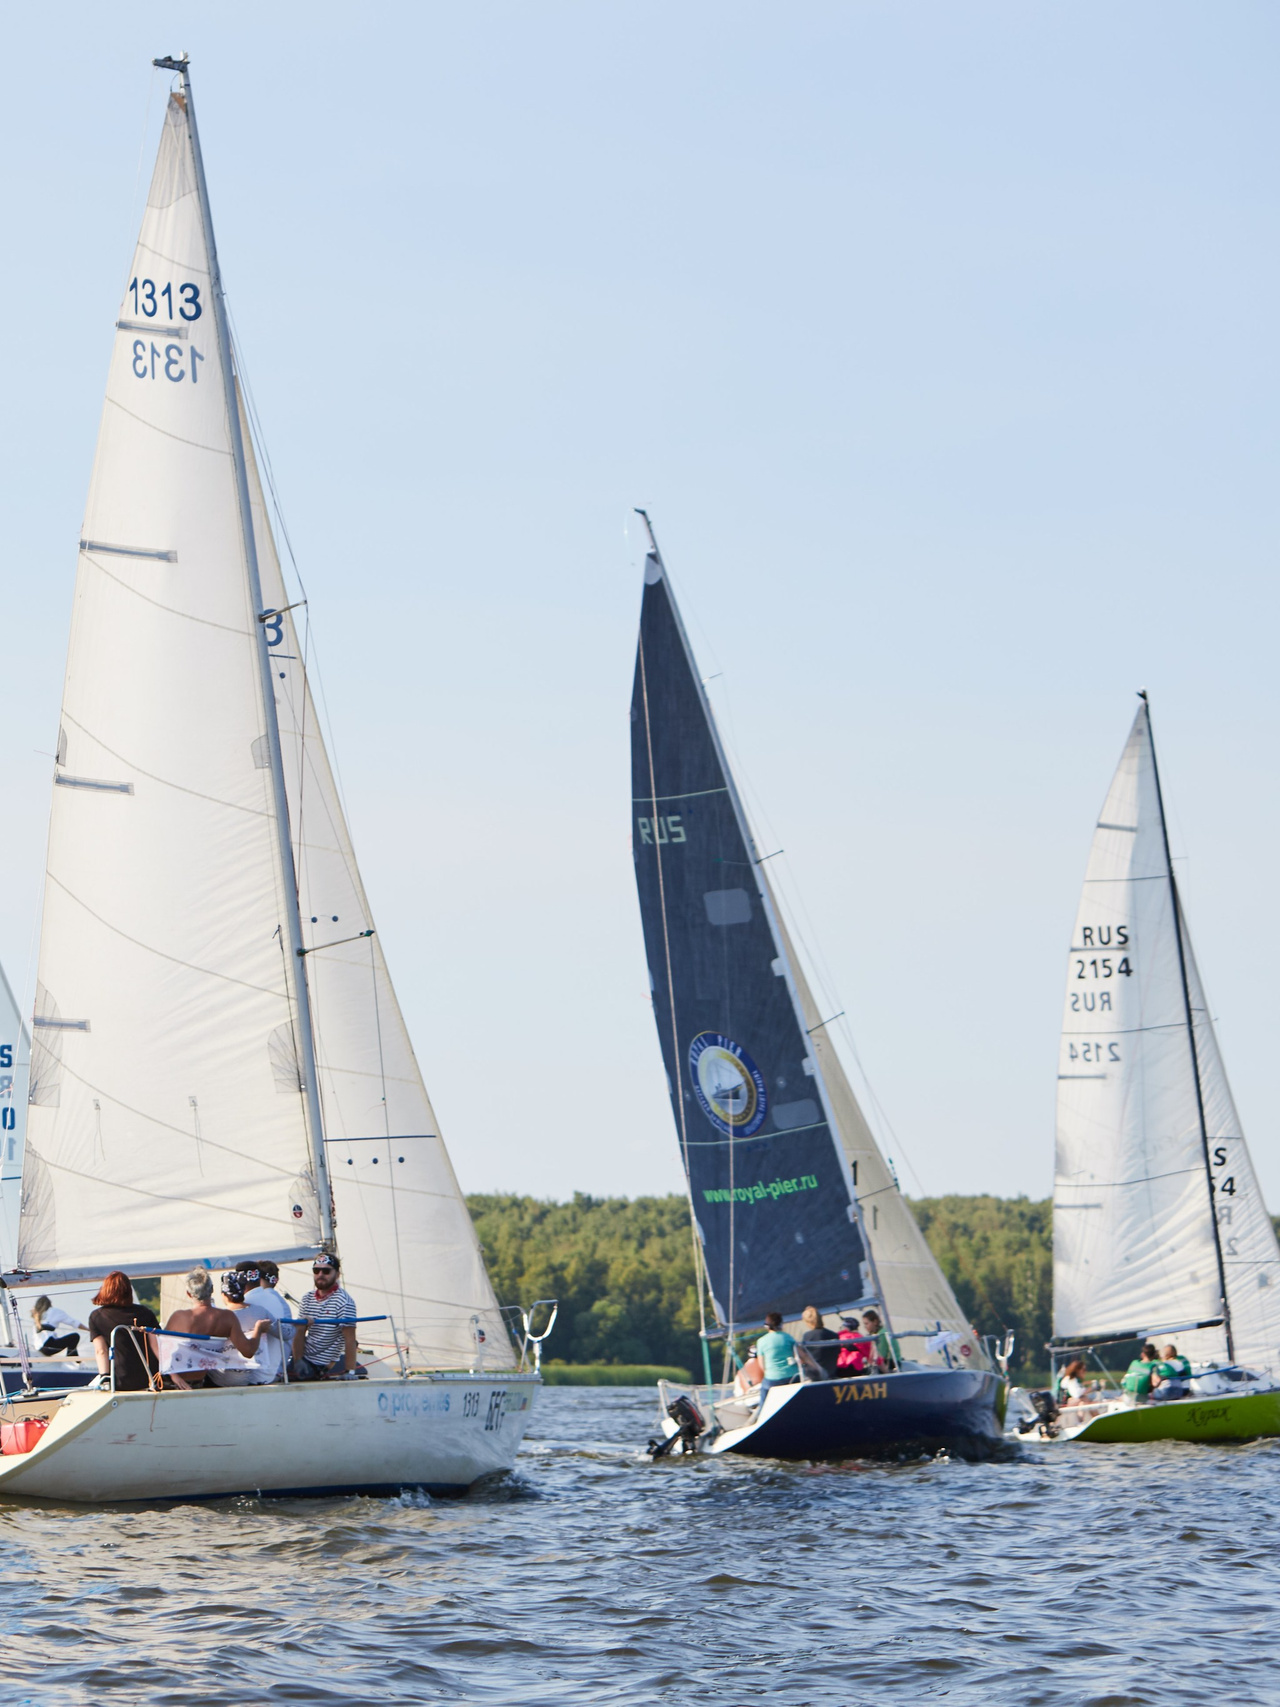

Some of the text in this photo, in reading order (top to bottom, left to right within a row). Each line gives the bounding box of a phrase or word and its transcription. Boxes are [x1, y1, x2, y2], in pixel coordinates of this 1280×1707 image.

[129, 276, 202, 321] 1313
[637, 815, 687, 844] RUS
[1082, 926, 1129, 946] RUS
[1076, 957, 1133, 979] 2154
[832, 1382, 888, 1405] УЛАН
